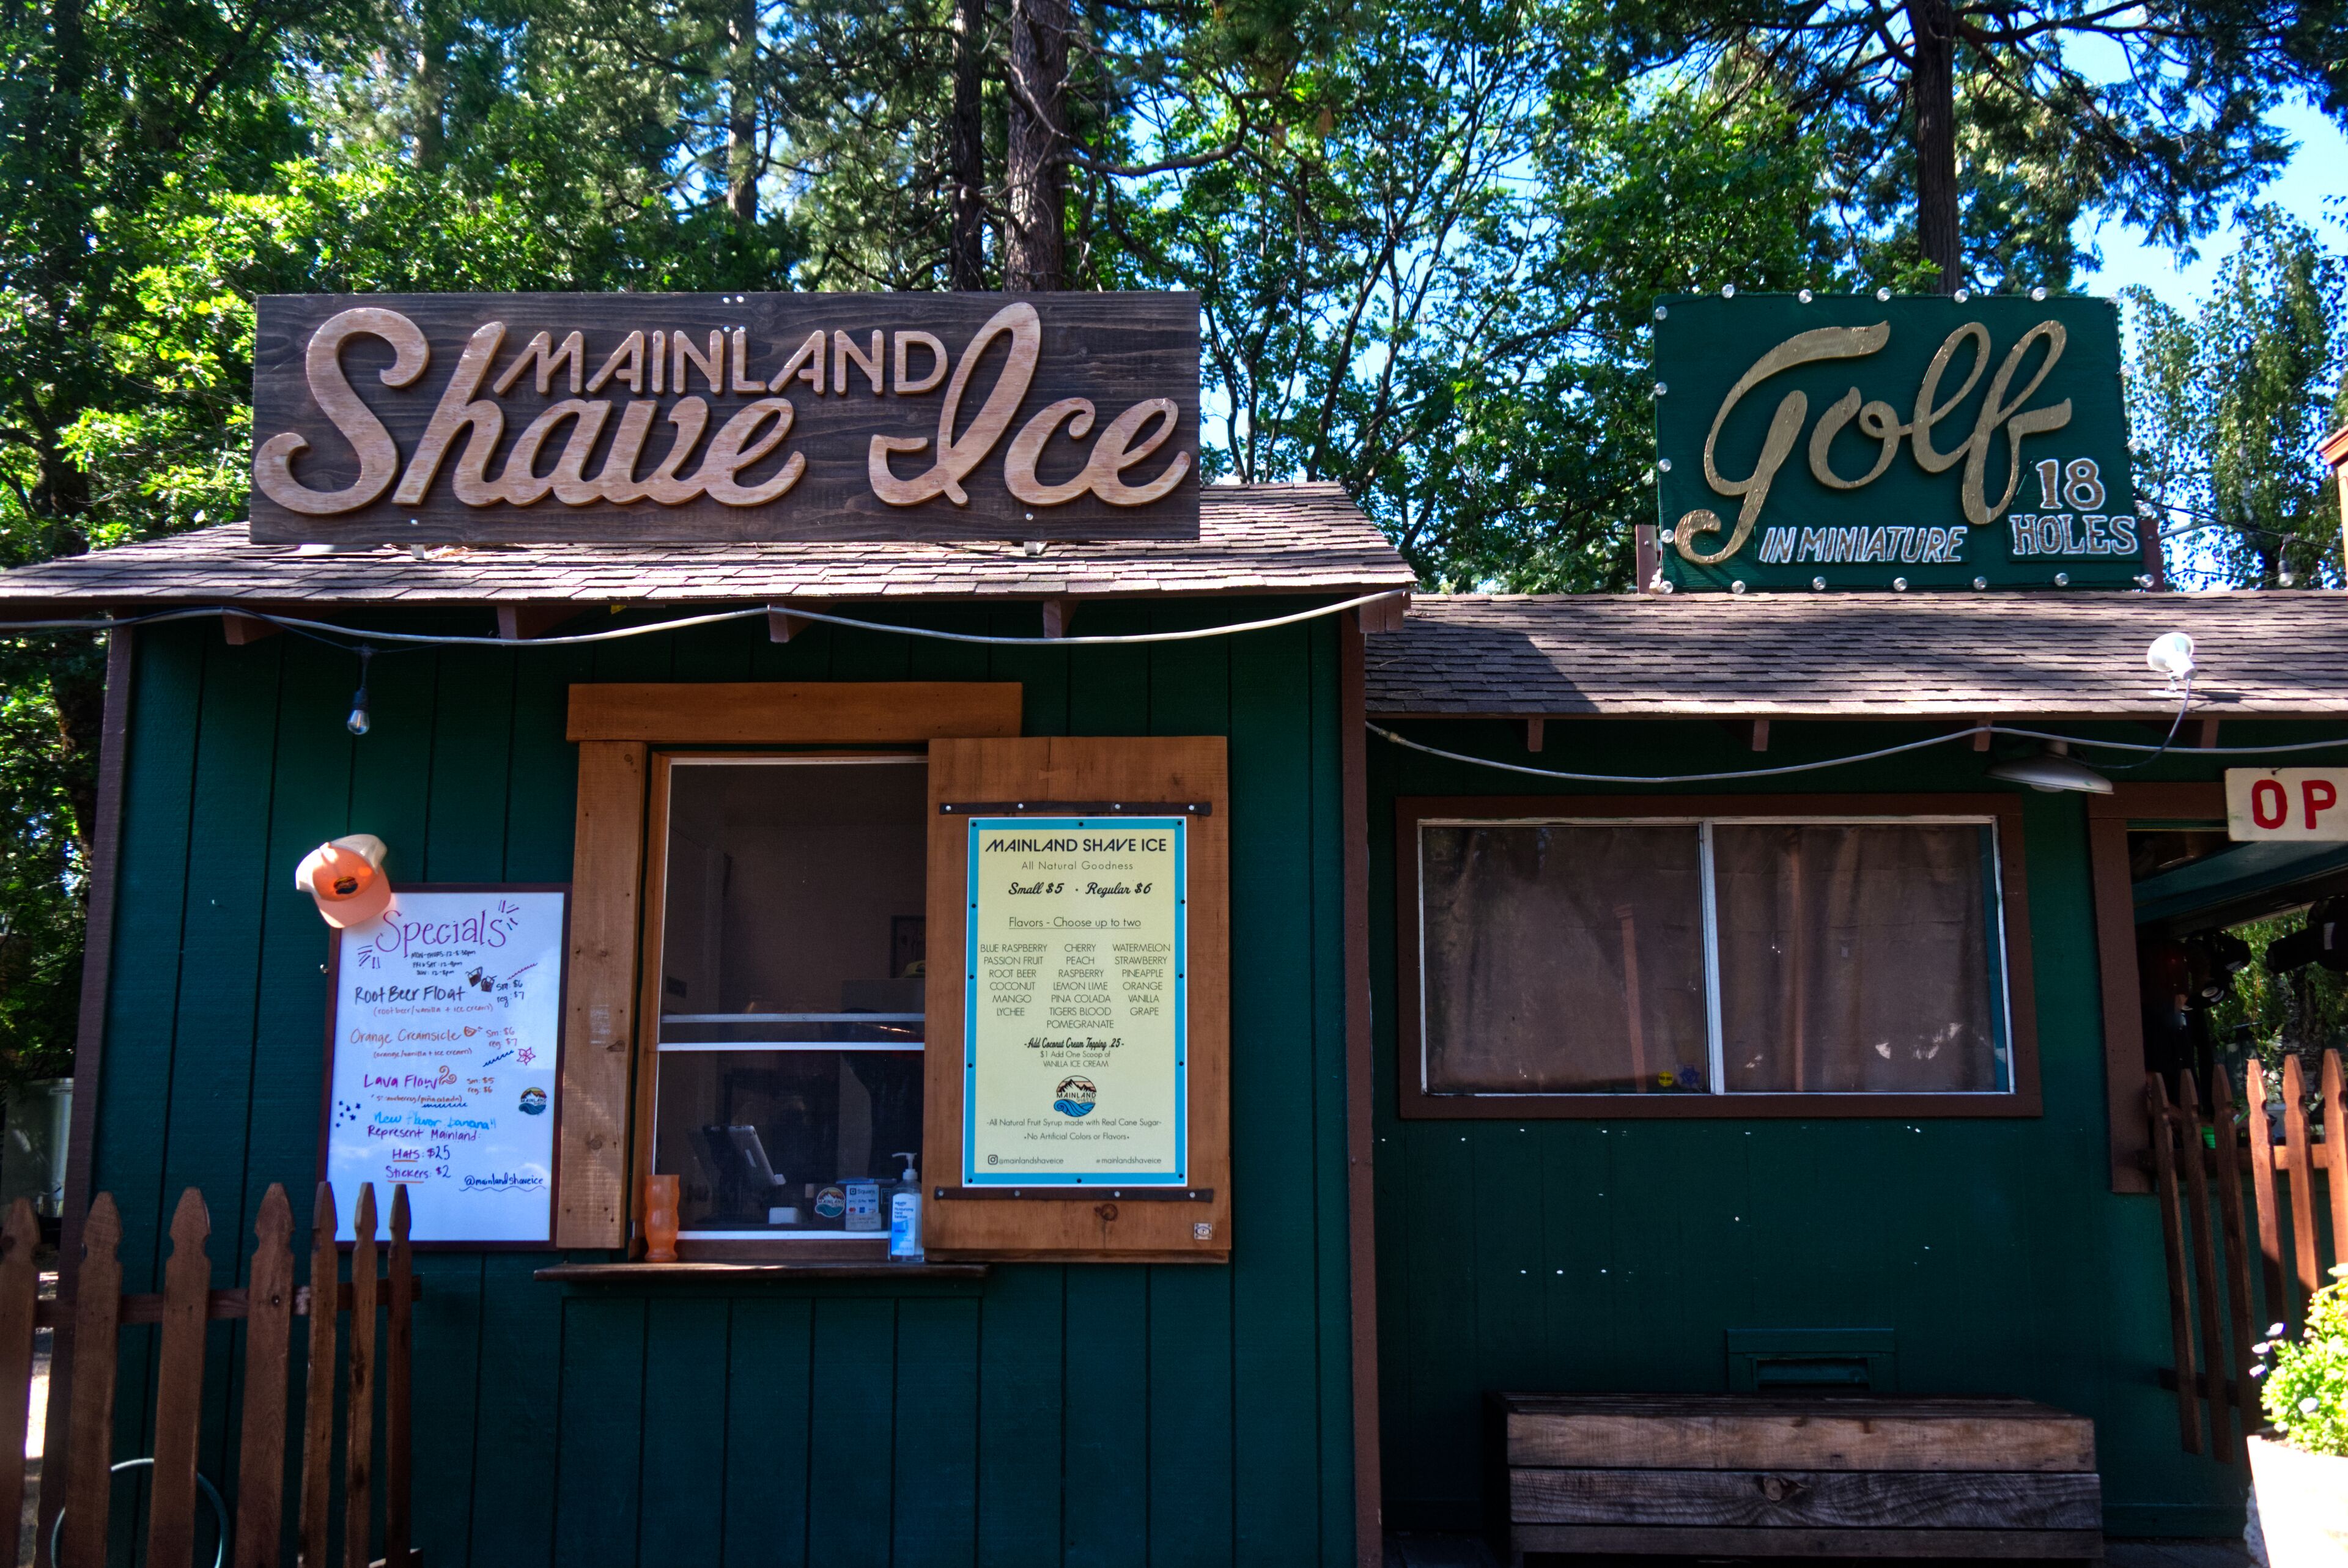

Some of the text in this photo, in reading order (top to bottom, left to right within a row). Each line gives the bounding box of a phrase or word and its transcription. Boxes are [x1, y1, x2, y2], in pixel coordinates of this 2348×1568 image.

[493, 329, 948, 396] MAINLAND
[253, 302, 1191, 516] Shave Ice
[1674, 320, 2072, 565] Golf
[2035, 458, 2106, 511] 18
[2009, 513, 2138, 554] HOLES
[1759, 526, 1968, 563] IN MINIATURE
[986, 839, 1166, 852] MAINLAND SHAVE ICE
[1022, 861, 1133, 870] All Natural Goodness
[1008, 882, 1065, 894] Small $5
[1085, 882, 1153, 897] Regular $6
[1009, 917, 1043, 927] Flavors
[1054, 917, 1091, 927] Choose
[1095, 919, 1107, 929] up
[1111, 918, 1120, 927] to
[1123, 918, 1141, 927] two
[375, 910, 506, 958] Specials
[980, 944, 1047, 952] BLUE RASPBERRY
[1065, 943, 1096, 952] CHERRY
[1112, 943, 1170, 952] WATERMELON
[984, 956, 1043, 965] PASSION FRUIT
[1066, 956, 1095, 965] PEACH
[1115, 956, 1167, 965] STRAWBERRY
[1058, 969, 1104, 977] RASPBERRY
[1122, 969, 1163, 977] PINEAPPLE
[512, 979, 523, 988] $6
[989, 982, 1035, 990] COCONUT
[1054, 982, 1085, 990] LEMON
[1123, 982, 1163, 990] ORANGE
[355, 985, 467, 1004] Root Beer Float
[514, 992, 524, 1001] $7
[997, 1007, 1025, 1016] LYCHEE
[1049, 1007, 1112, 1015] TIGERS BLOOD
[1130, 1007, 1159, 1015] GRAPE
[1047, 1020, 1114, 1028] POMEGRANATE
[503, 1027, 515, 1036] $6
[350, 1028, 462, 1048] Orange Creamsicle
[506, 1038, 518, 1047] $7
[1042, 1037, 1065, 1048] Coconut
[1066, 1037, 1084, 1048] Cream
[1086, 1037, 1107, 1051] Topping
[364, 1074, 438, 1089] Lava Flow
[374, 1111, 402, 1124] New
[367, 1125, 424, 1140] Represent
[427, 1144, 451, 1160] $25
[435, 1165, 451, 1179] $2
